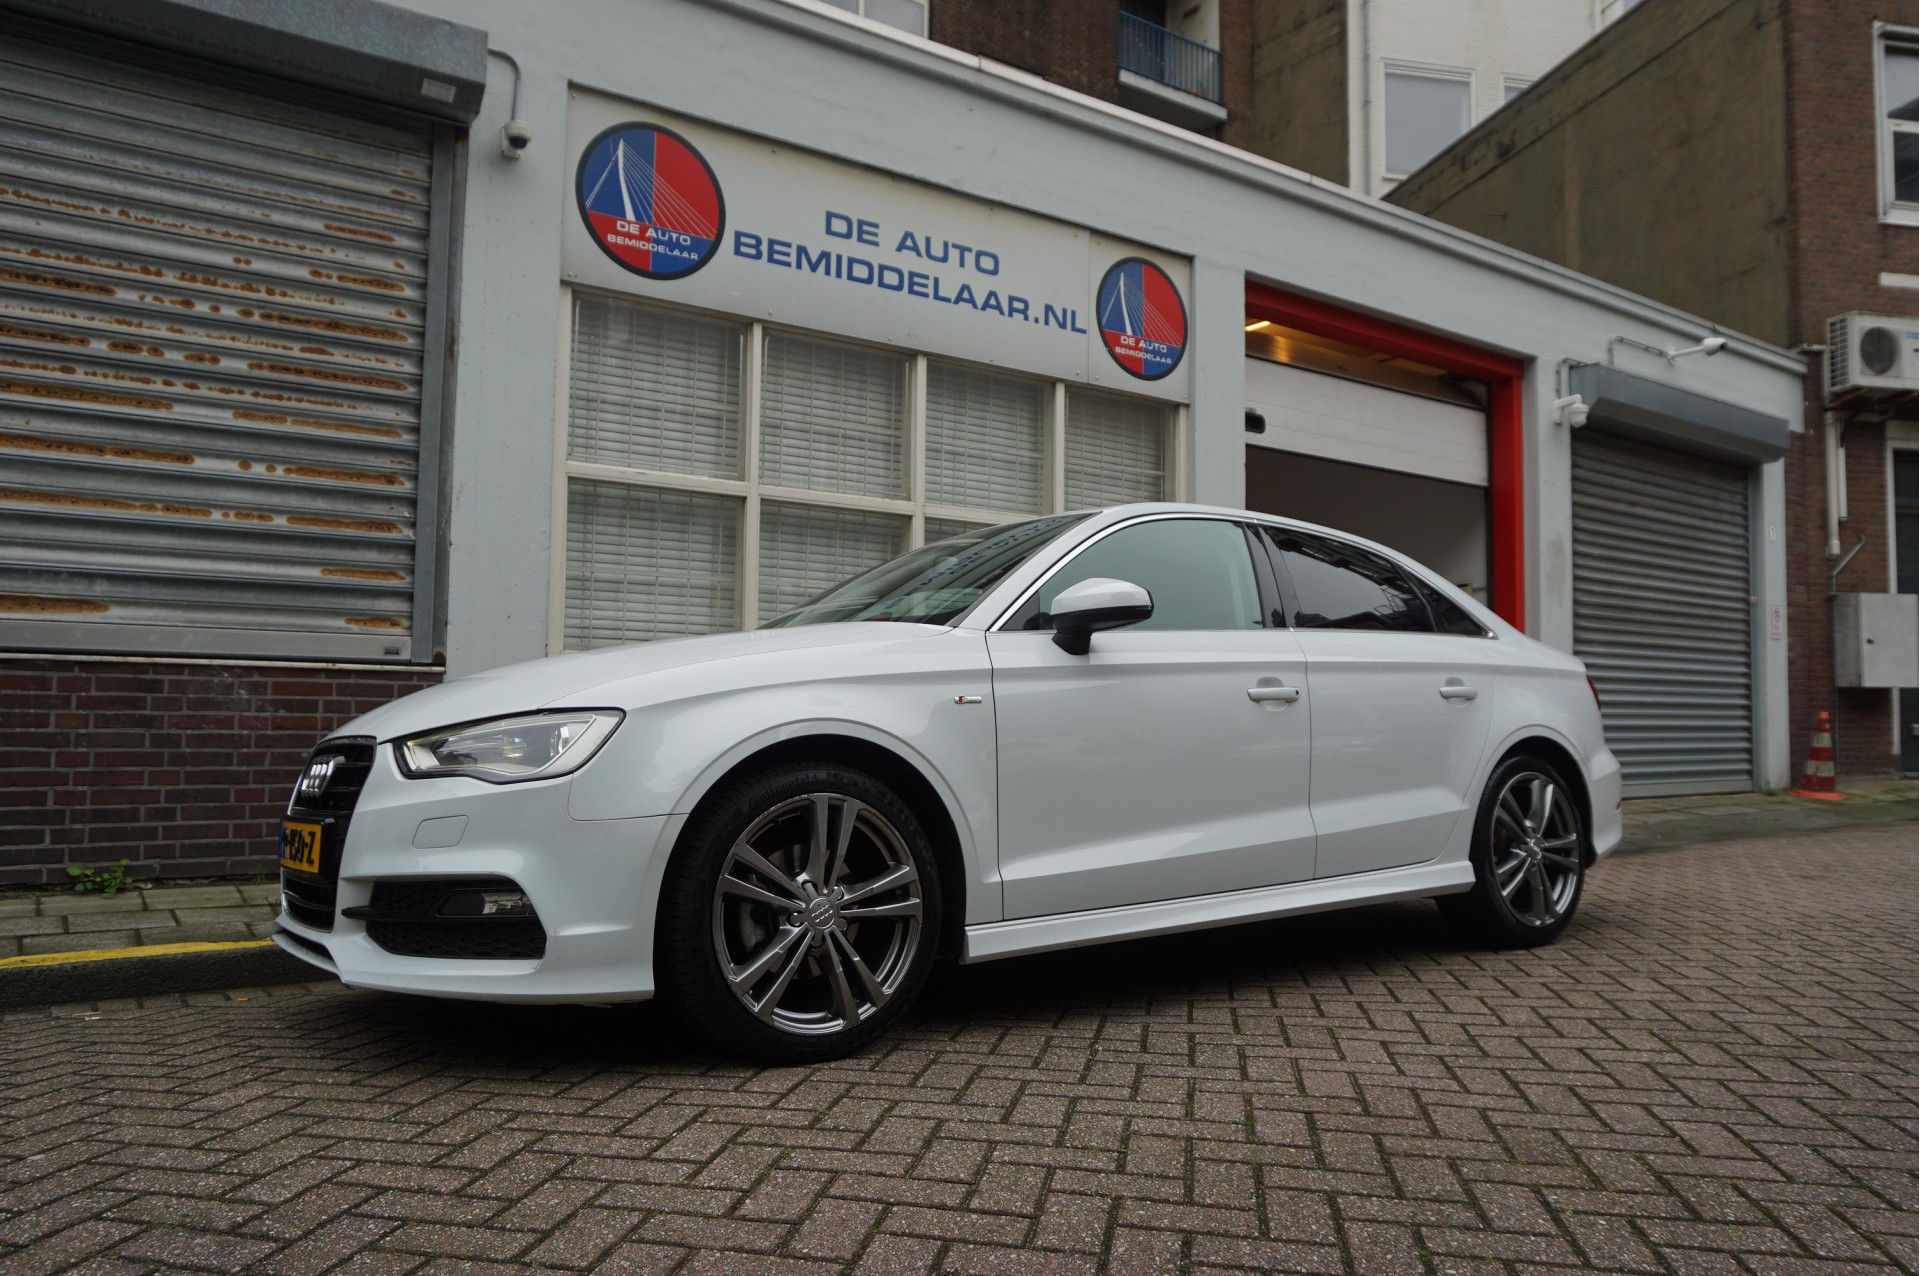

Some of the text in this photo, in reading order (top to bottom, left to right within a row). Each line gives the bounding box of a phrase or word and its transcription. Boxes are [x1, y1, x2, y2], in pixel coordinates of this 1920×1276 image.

[616, 220, 691, 245] DE AUTO
[825, 210, 1000, 277] DE AUTO
[607, 233, 699, 260] BEMIDDELAAR
[733, 229, 1088, 335] BEMIDDELAAR.NL
[1115, 346, 1172, 364] BEMIDDELAAR
[1120, 335, 1167, 353] DE AUTO
